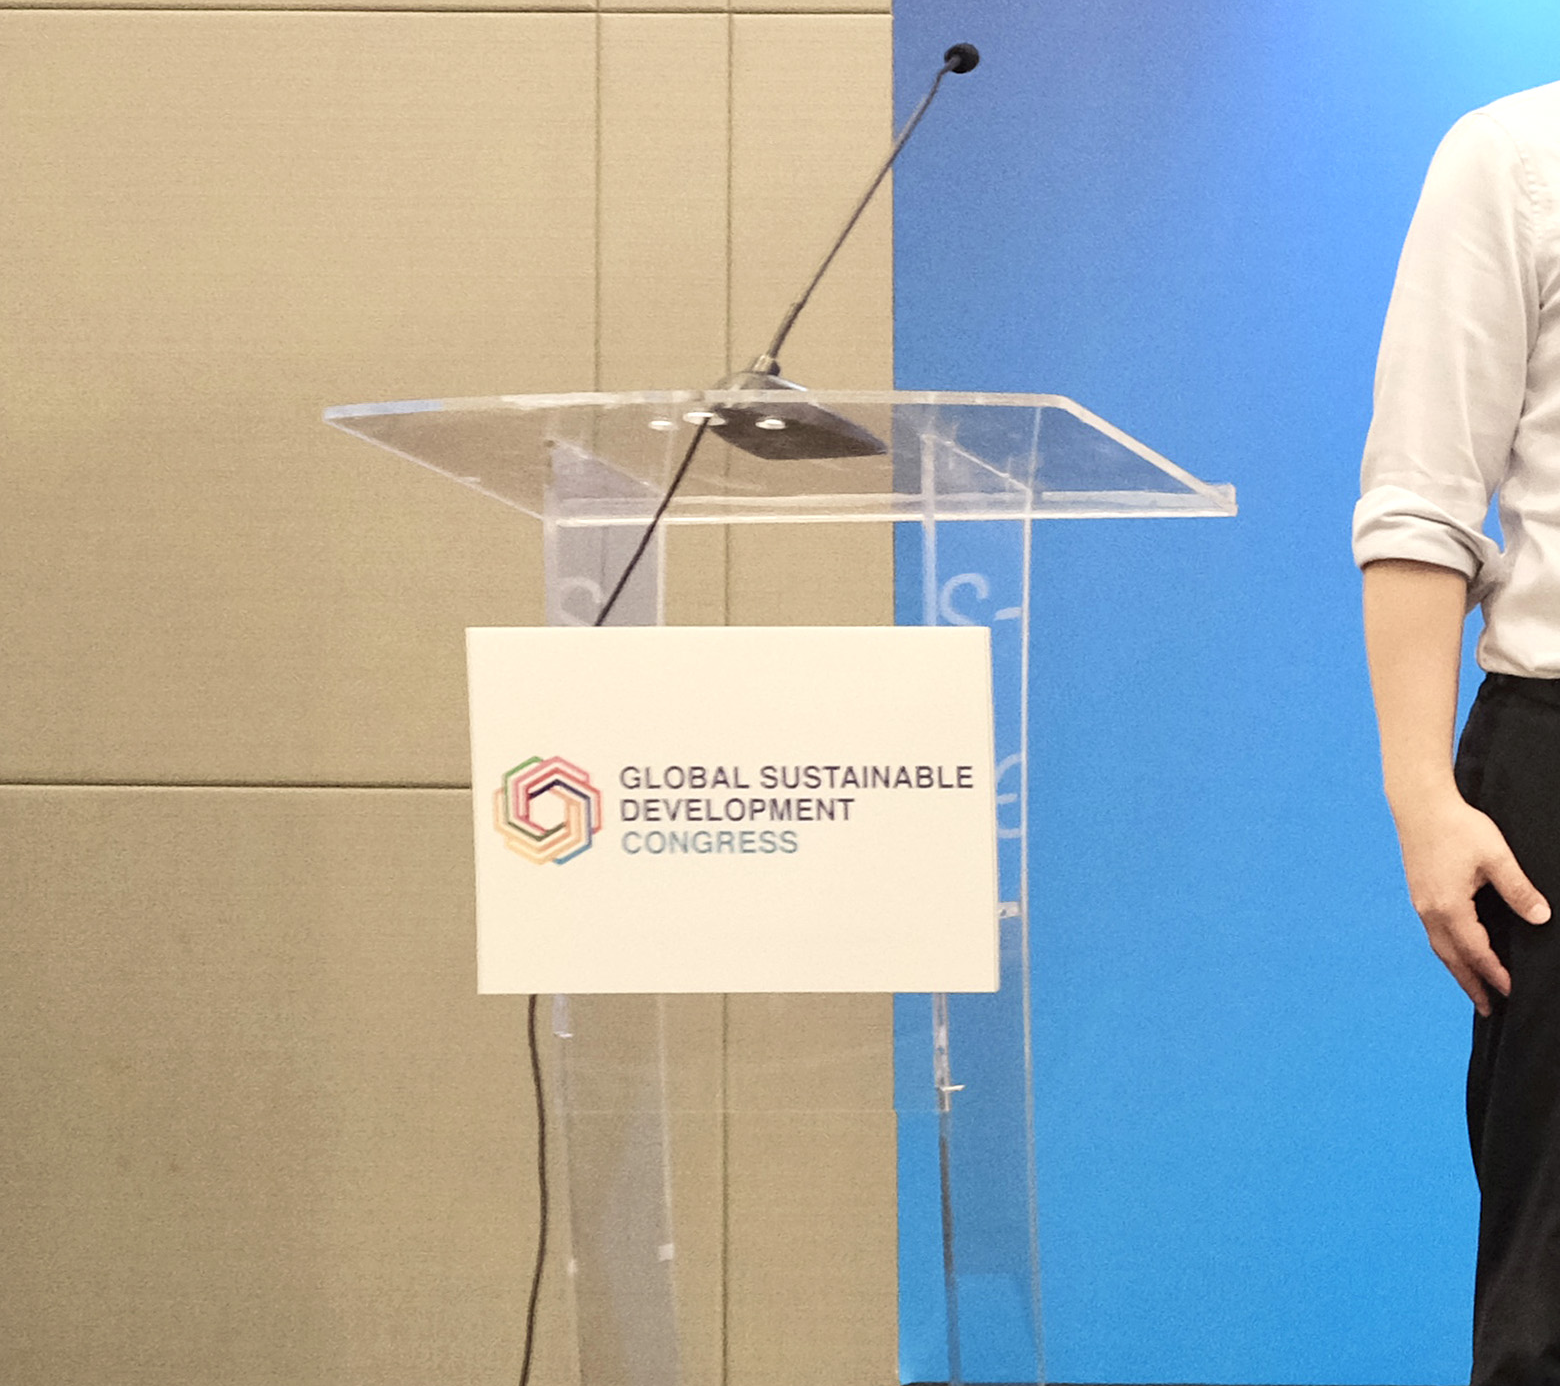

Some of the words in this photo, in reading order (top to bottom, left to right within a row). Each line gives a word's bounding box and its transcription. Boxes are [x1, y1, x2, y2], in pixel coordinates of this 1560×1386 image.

[620, 765, 750, 790] GLOBAL
[760, 765, 974, 790] SUSTAINABLE
[621, 797, 855, 823] DEVELOPMENT
[621, 829, 799, 856] CONGRESS
